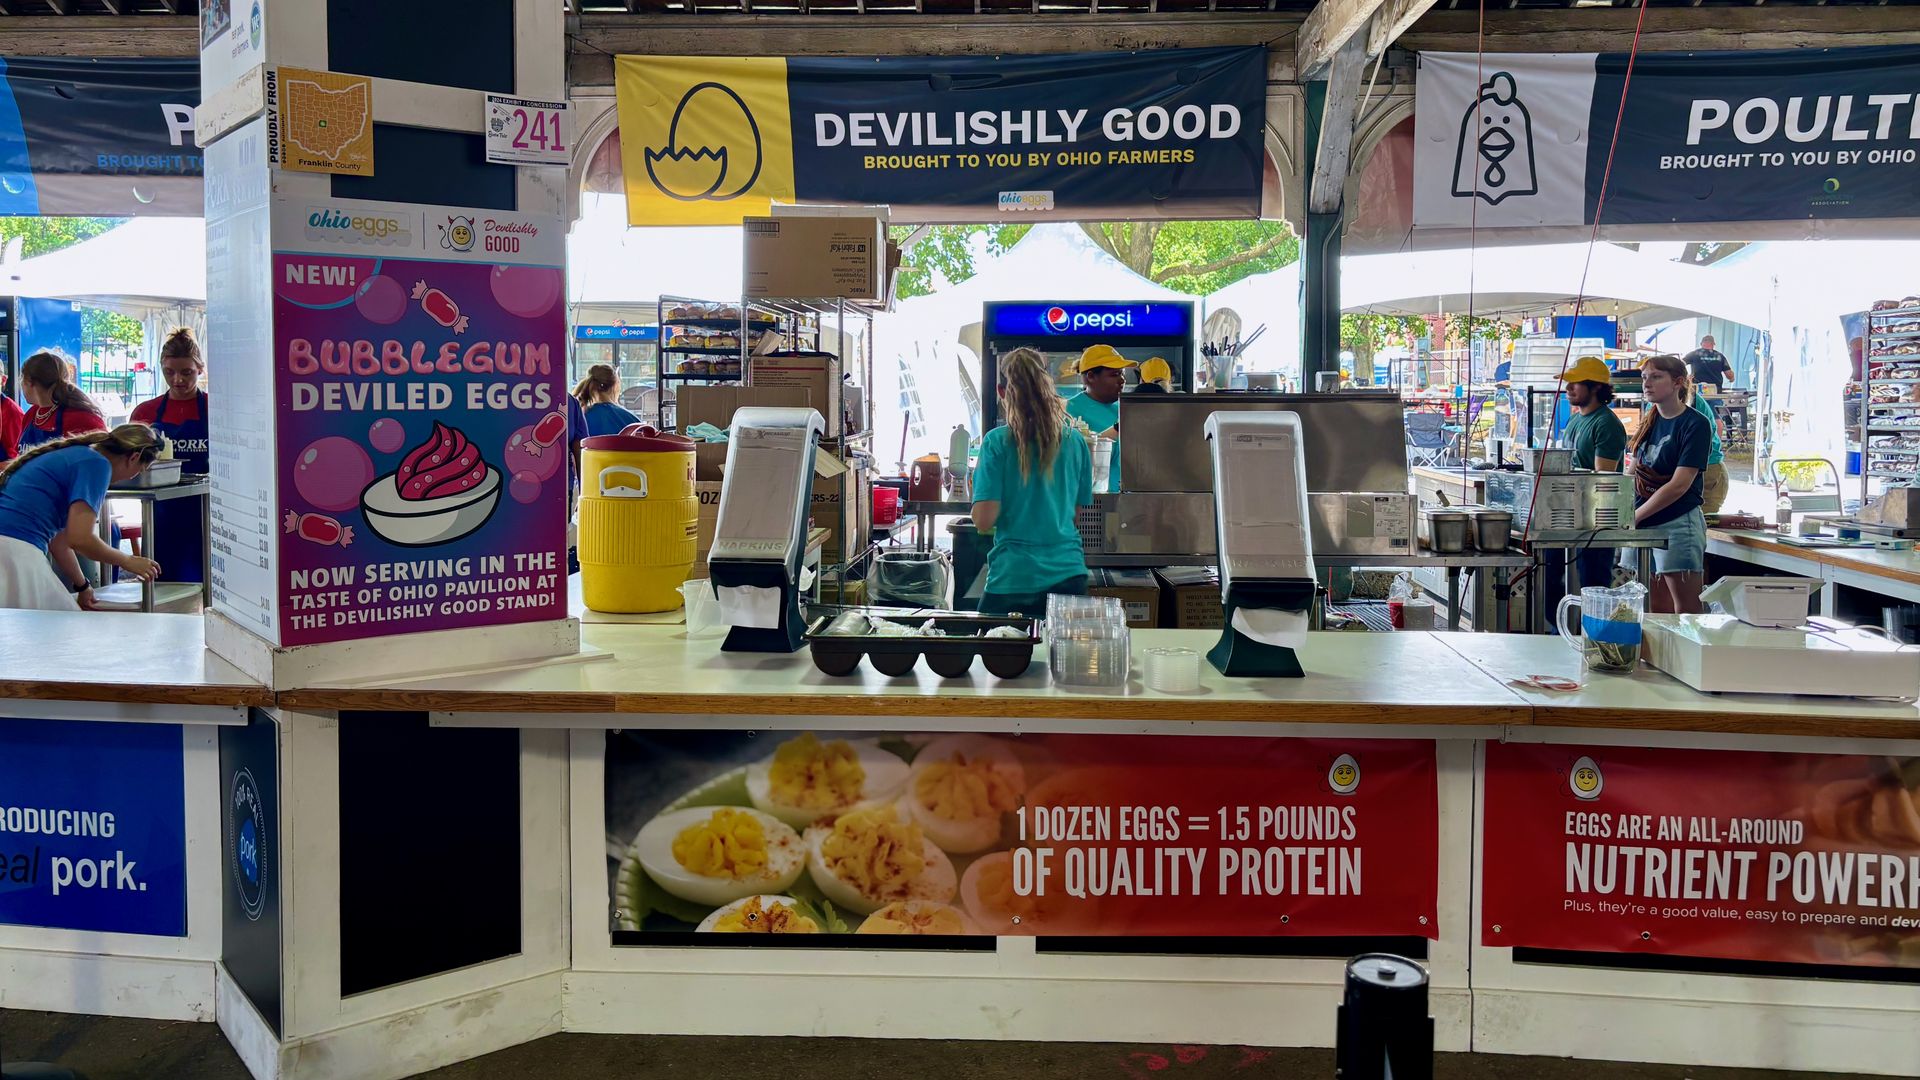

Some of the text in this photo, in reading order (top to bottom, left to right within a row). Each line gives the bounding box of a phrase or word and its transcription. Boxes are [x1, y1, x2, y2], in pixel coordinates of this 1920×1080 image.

[266, 70, 279, 164] PROUDLY FROM
[503, 98, 522, 106] EXHIBIT
[526, 101, 563, 109] CONCESSION
[512, 108, 565, 152] 241
[814, 104, 1242, 148] DEVILISHLY GOOD
[97, 154, 180, 169] BROUGHT
[298, 158, 361, 171] Franklin County
[864, 148, 1196, 170] BROUGHT TO YOU BY OHIO FARMERS
[1660, 149, 1916, 170] BROUGHT TO YOU BY OHIO
[484, 219, 538, 238] Devilishly
[484, 236, 520, 253] GOOD
[286, 263, 356, 286] NEW!
[1074, 310, 1132, 331] pepsi
[288, 338, 551, 376] BUBBLEGUM
[292, 382, 453, 412] DEVILED
[466, 382, 552, 410] EGGS
[718, 541, 784, 550] NAPKINS
[290, 552, 556, 590] NOW SERVING IN THE
[290, 574, 558, 610] TASTE OF OHIO PAVILION AT
[290, 592, 556, 630] THE DEVILISHLY GOOD STAND!
[246, 786, 259, 828] REAL
[1016, 806, 1026, 840] 1
[1034, 806, 1110, 840] DOZEN
[1120, 806, 1180, 841] EGGS
[1217, 806, 1250, 840] 1.5
[1258, 806, 1357, 841] POUNDS
[1565, 811, 1804, 845] EGGS ARE AN ALL-AROUND
[240, 832, 258, 868] pork
[52, 850, 147, 896] pork.
[1012, 847, 1362, 899] OF QUALITY PROTEIN
[1566, 842, 1757, 900] NUTRIENT
[1564, 900, 1595, 913] Plus,
[1599, 900, 1646, 916] they're
[1650, 906, 1658, 916] a
[1662, 906, 1698, 920] good
[1702, 906, 1742, 920] value,
[1746, 911, 1778, 924] easy
[1782, 910, 1796, 922] to
[1800, 913, 1856, 928] prepare
[1860, 915, 1888, 926] and
